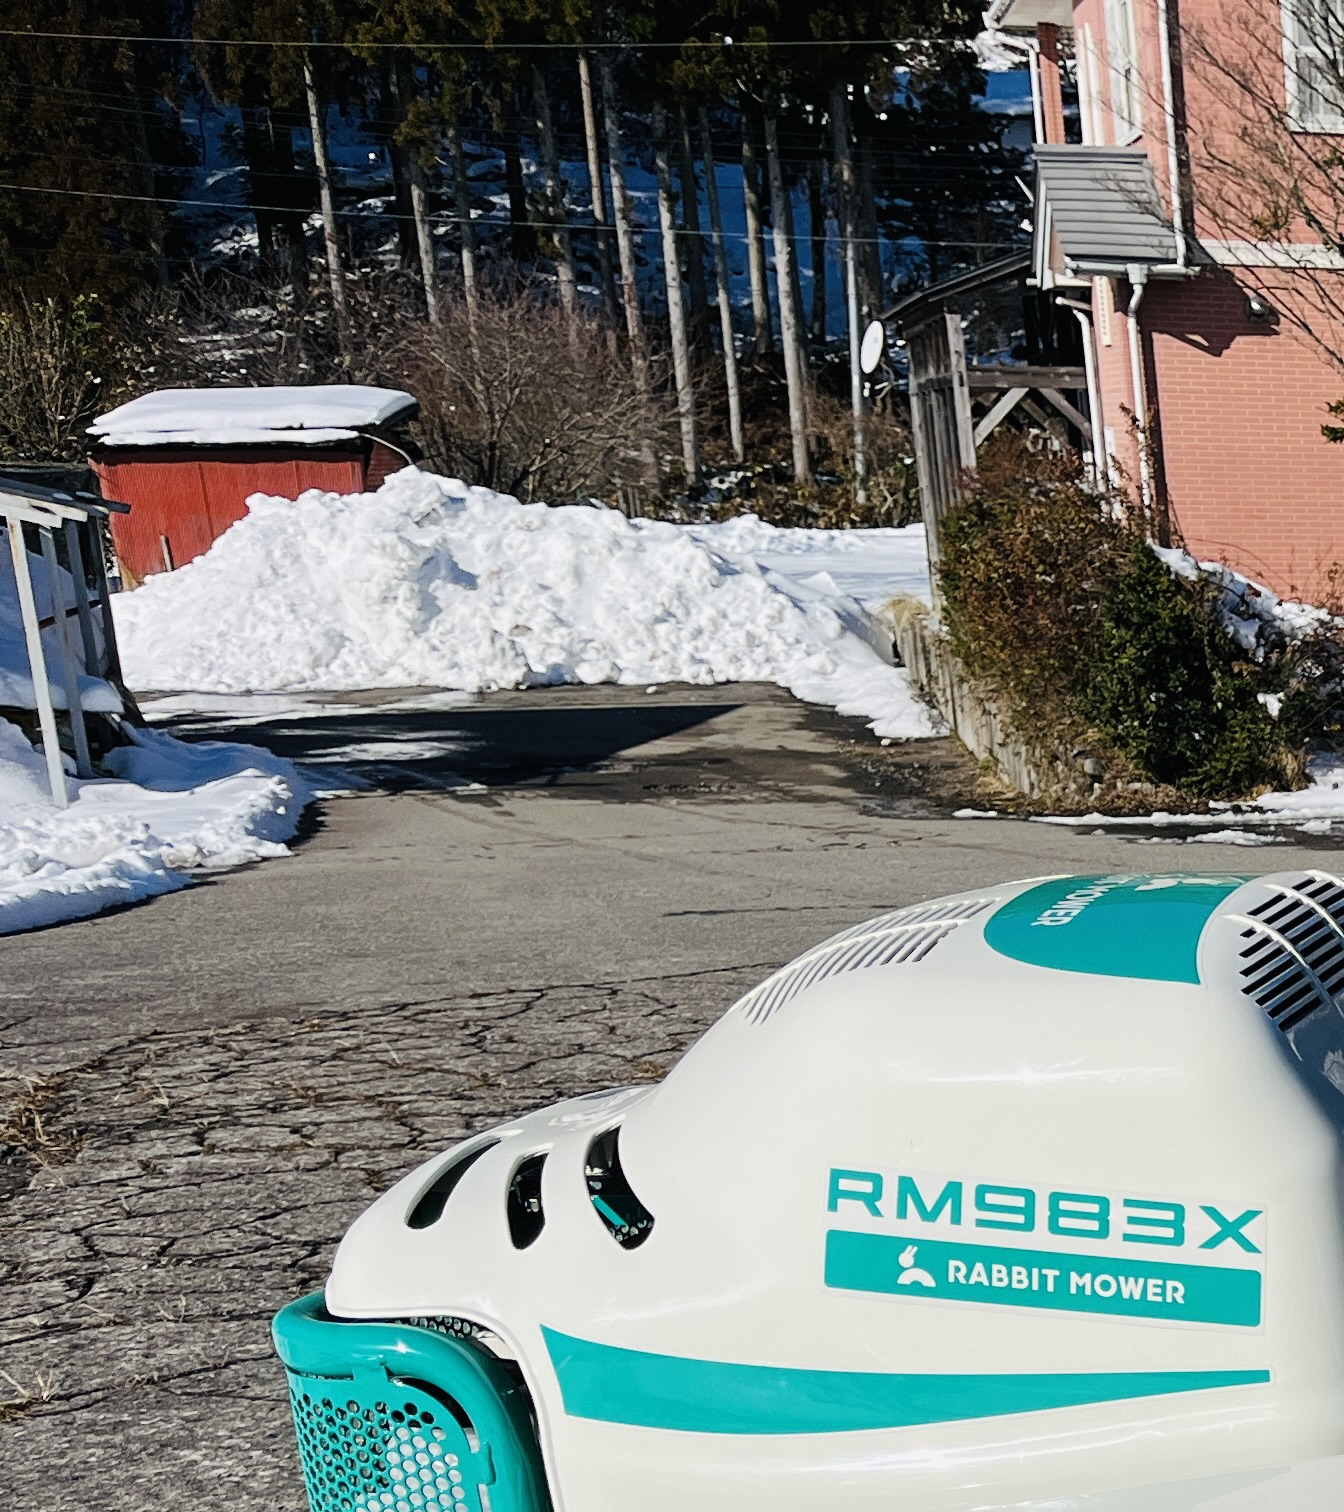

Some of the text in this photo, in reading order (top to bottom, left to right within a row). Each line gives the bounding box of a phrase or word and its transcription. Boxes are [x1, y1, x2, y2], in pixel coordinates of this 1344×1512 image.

[827, 1167, 1263, 1254] RM983X
[947, 1260, 1186, 1305] RABBIT MOWER
